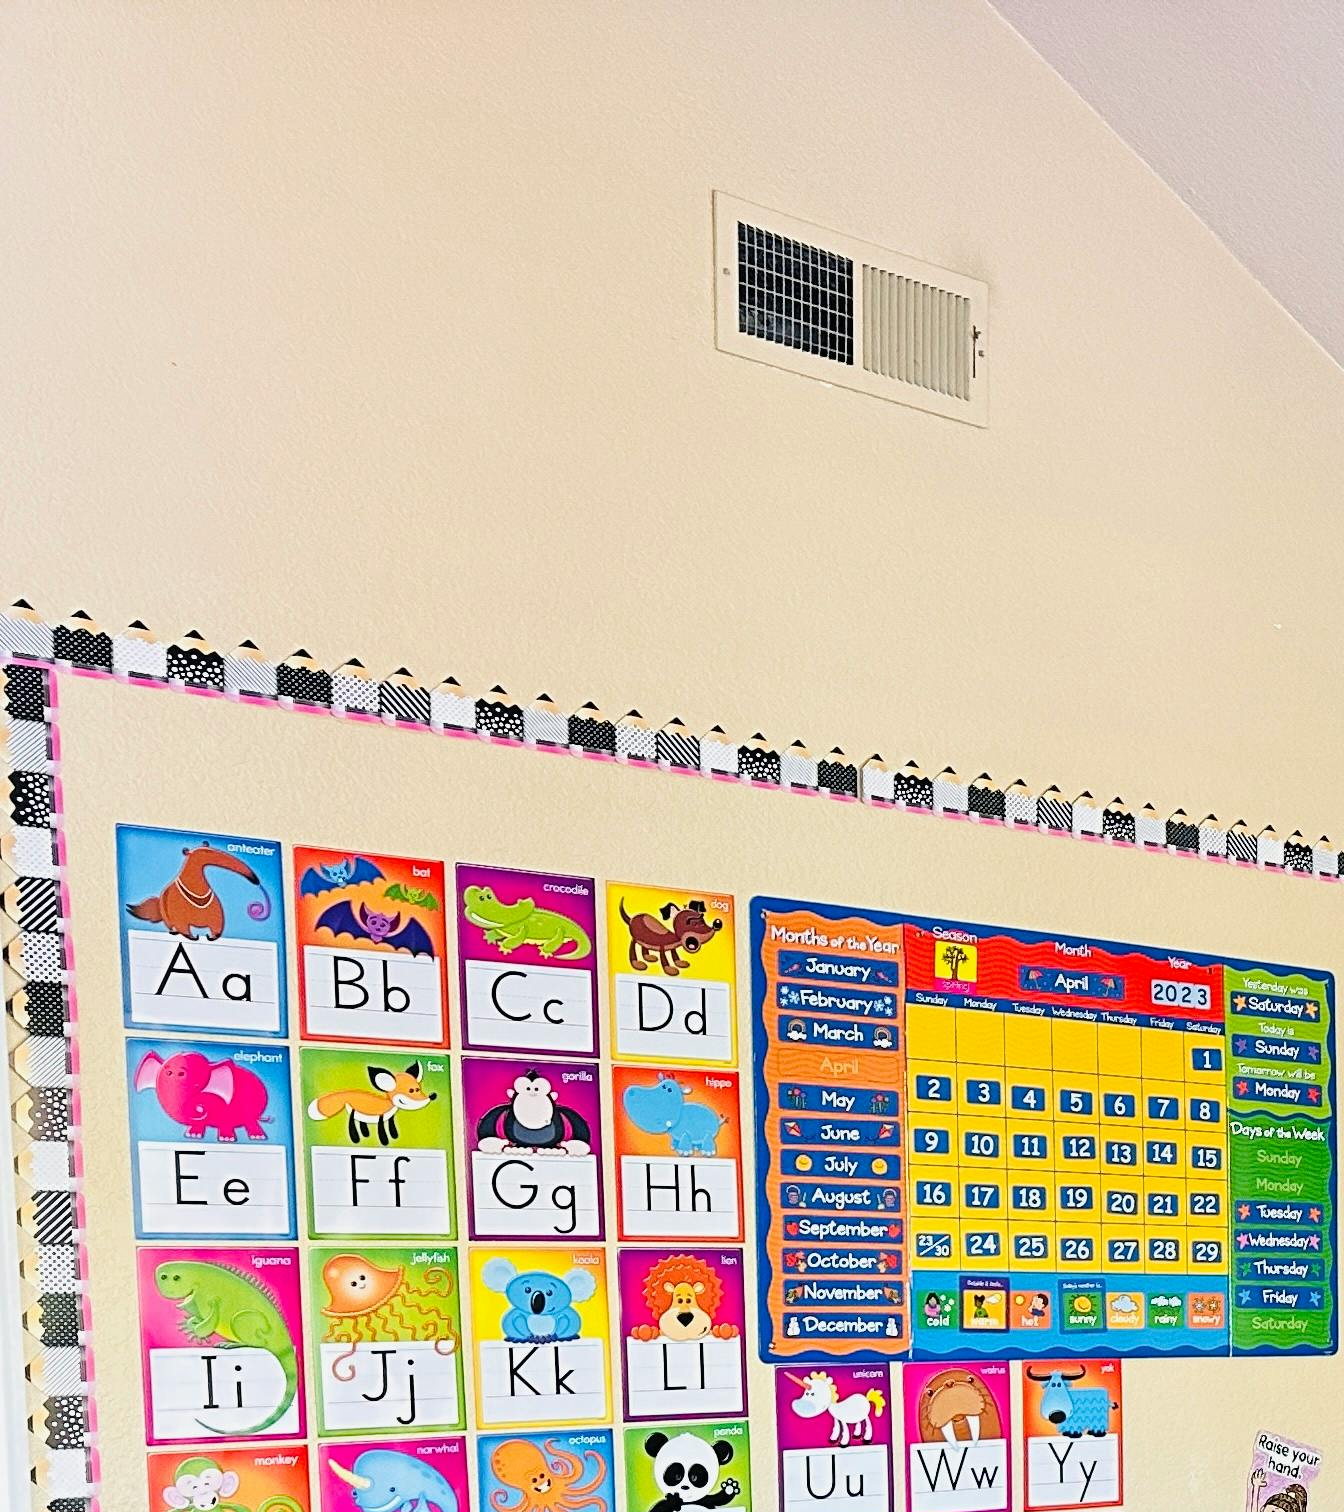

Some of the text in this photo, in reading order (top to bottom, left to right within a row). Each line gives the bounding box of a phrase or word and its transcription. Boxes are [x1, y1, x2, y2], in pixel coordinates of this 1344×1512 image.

[226, 842, 276, 857] anteater
[412, 866, 431, 879] bat
[542, 883, 589, 896] crocodile
[771, 925, 900, 954] Months of the Year
[933, 927, 978, 943] Season
[1055, 942, 1091, 958] Month
[806, 958, 871, 981] January
[1167, 956, 1192, 970] Year
[1054, 973, 1089, 993] April
[1243, 978, 1308, 995] Yesterday was
[800, 990, 873, 1015] February
[1153, 984, 1208, 1006] 2023
[1248, 997, 1303, 1017] Saturday
[813, 1022, 864, 1042] March
[1258, 1022, 1295, 1037] Today is
[233, 1050, 283, 1065] elephant
[1255, 1040, 1299, 1060] Sunday
[561, 1070, 593, 1083] gorilla
[1236, 1063, 1286, 1076] Tomorrow
[822, 1091, 855, 1111] May
[1255, 1082, 1300, 1102] Monday
[820, 1125, 860, 1141] June
[1230, 1122, 1325, 1141] Days of the Week
[824, 1156, 858, 1176] July
[811, 1188, 871, 1210] August
[1256, 1204, 1302, 1222] Tuesday
[799, 1220, 888, 1239] September
[1249, 1233, 1310, 1250] Wednesday
[410, 1251, 451, 1266] jellyfish
[807, 1253, 877, 1268] October
[1253, 1260, 1308, 1278] Thursday
[804, 1282, 883, 1300] November
[1262, 1289, 1298, 1307] Friday
[803, 1316, 883, 1333] December
[416, 1441, 460, 1455] narwhal
[568, 1433, 607, 1447] octopus
[1259, 1434, 1320, 1466] Raise your
[254, 1454, 299, 1468] monkey
[1268, 1456, 1301, 1479] hand.
